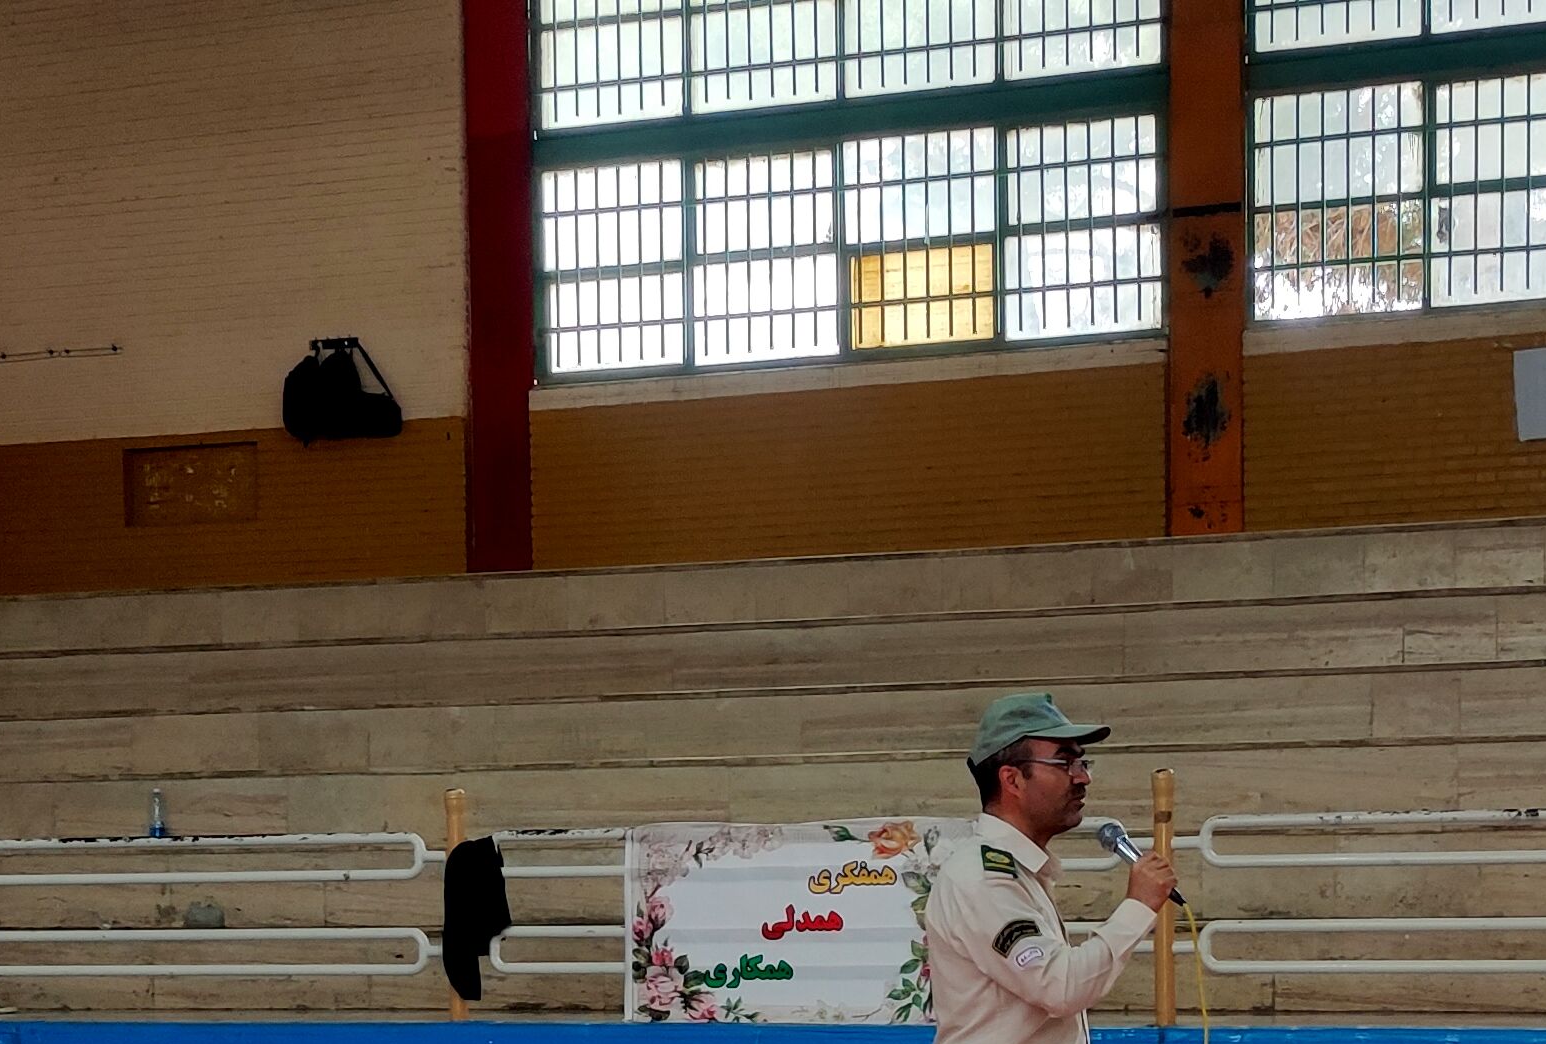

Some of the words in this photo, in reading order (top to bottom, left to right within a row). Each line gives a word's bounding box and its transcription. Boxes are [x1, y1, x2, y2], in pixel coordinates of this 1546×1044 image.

[808, 861, 897, 894] همفکری
[762, 904, 844, 940] همدلی
[704, 954, 794, 988] همکاری
